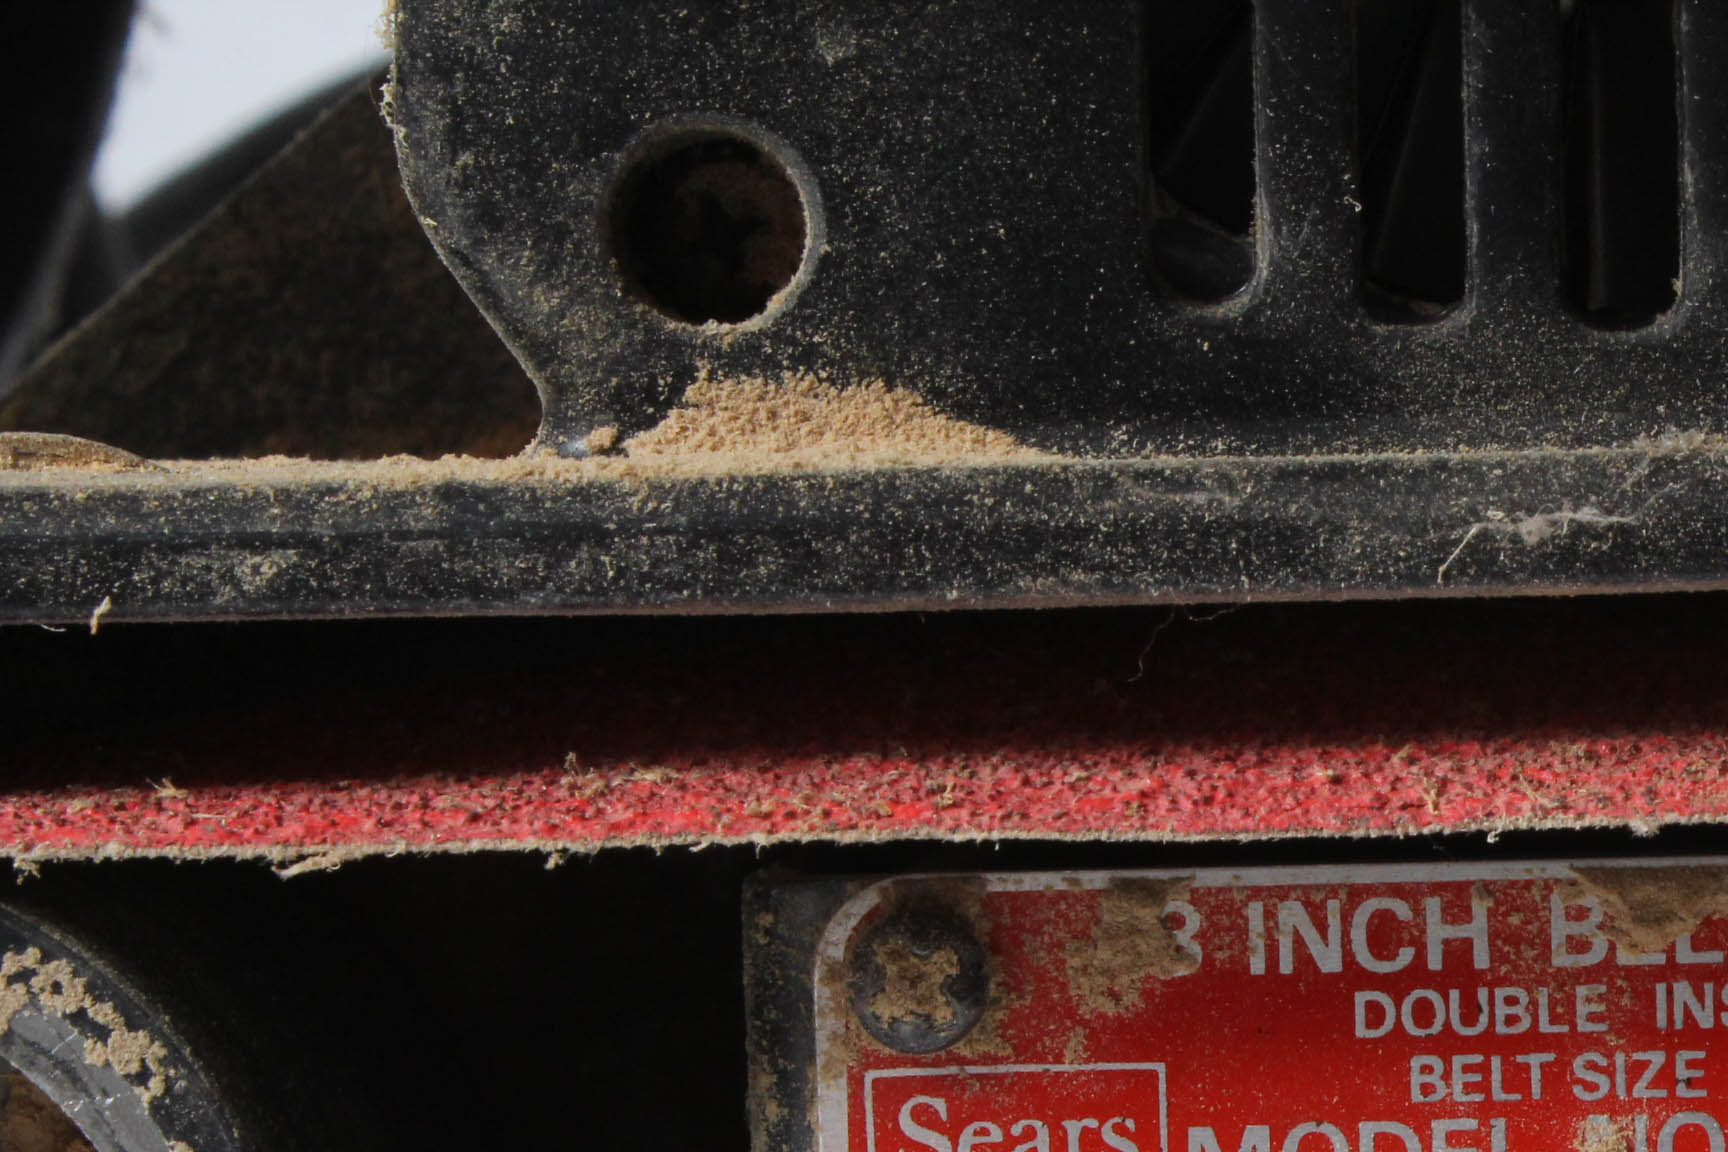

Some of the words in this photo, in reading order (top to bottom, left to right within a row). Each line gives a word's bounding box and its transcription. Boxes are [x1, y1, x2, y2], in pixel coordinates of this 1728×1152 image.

[1248, 897, 1492, 975] INCH
[1355, 984, 1608, 1038] DOUBLE
[1410, 1053, 1556, 1102] BELT
[1572, 1050, 1707, 1101] SIZE
